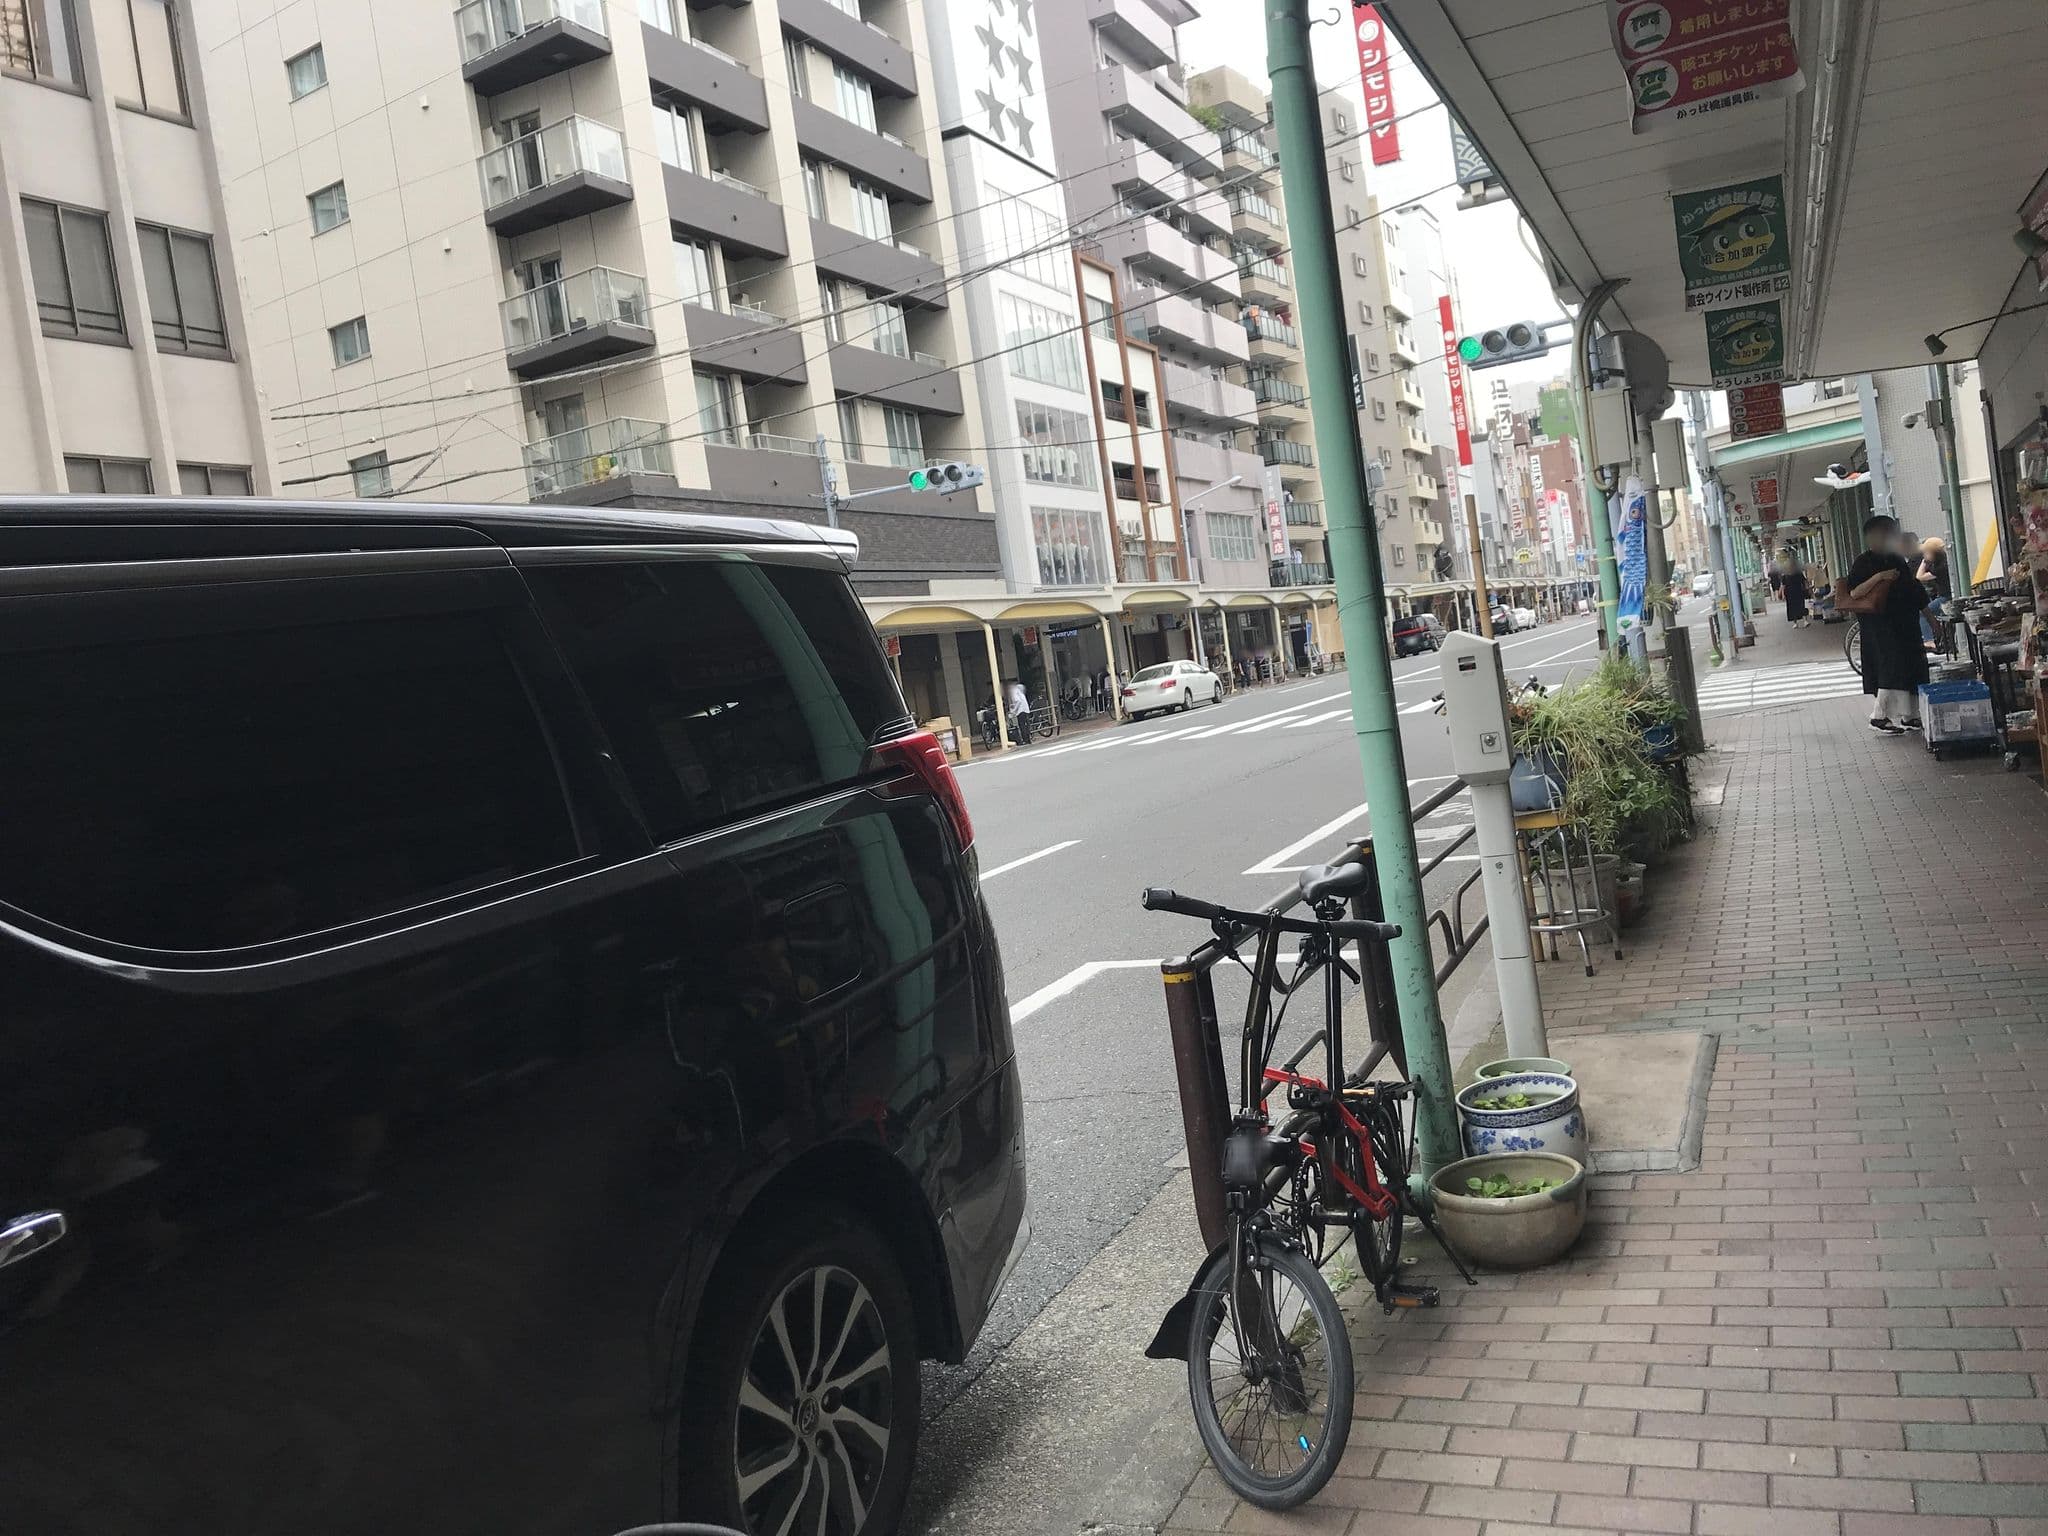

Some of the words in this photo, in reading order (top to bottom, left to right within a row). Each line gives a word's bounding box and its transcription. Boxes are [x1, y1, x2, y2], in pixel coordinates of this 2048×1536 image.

[1680, 32, 1792, 73] 咳エチケットを
[1692, 55, 1786, 90] お願いします
[1363, 49, 1391, 138] シモジマ
[1701, 243, 1768, 265] 組合加盟店
[1446, 344, 1461, 389] シモジマ
